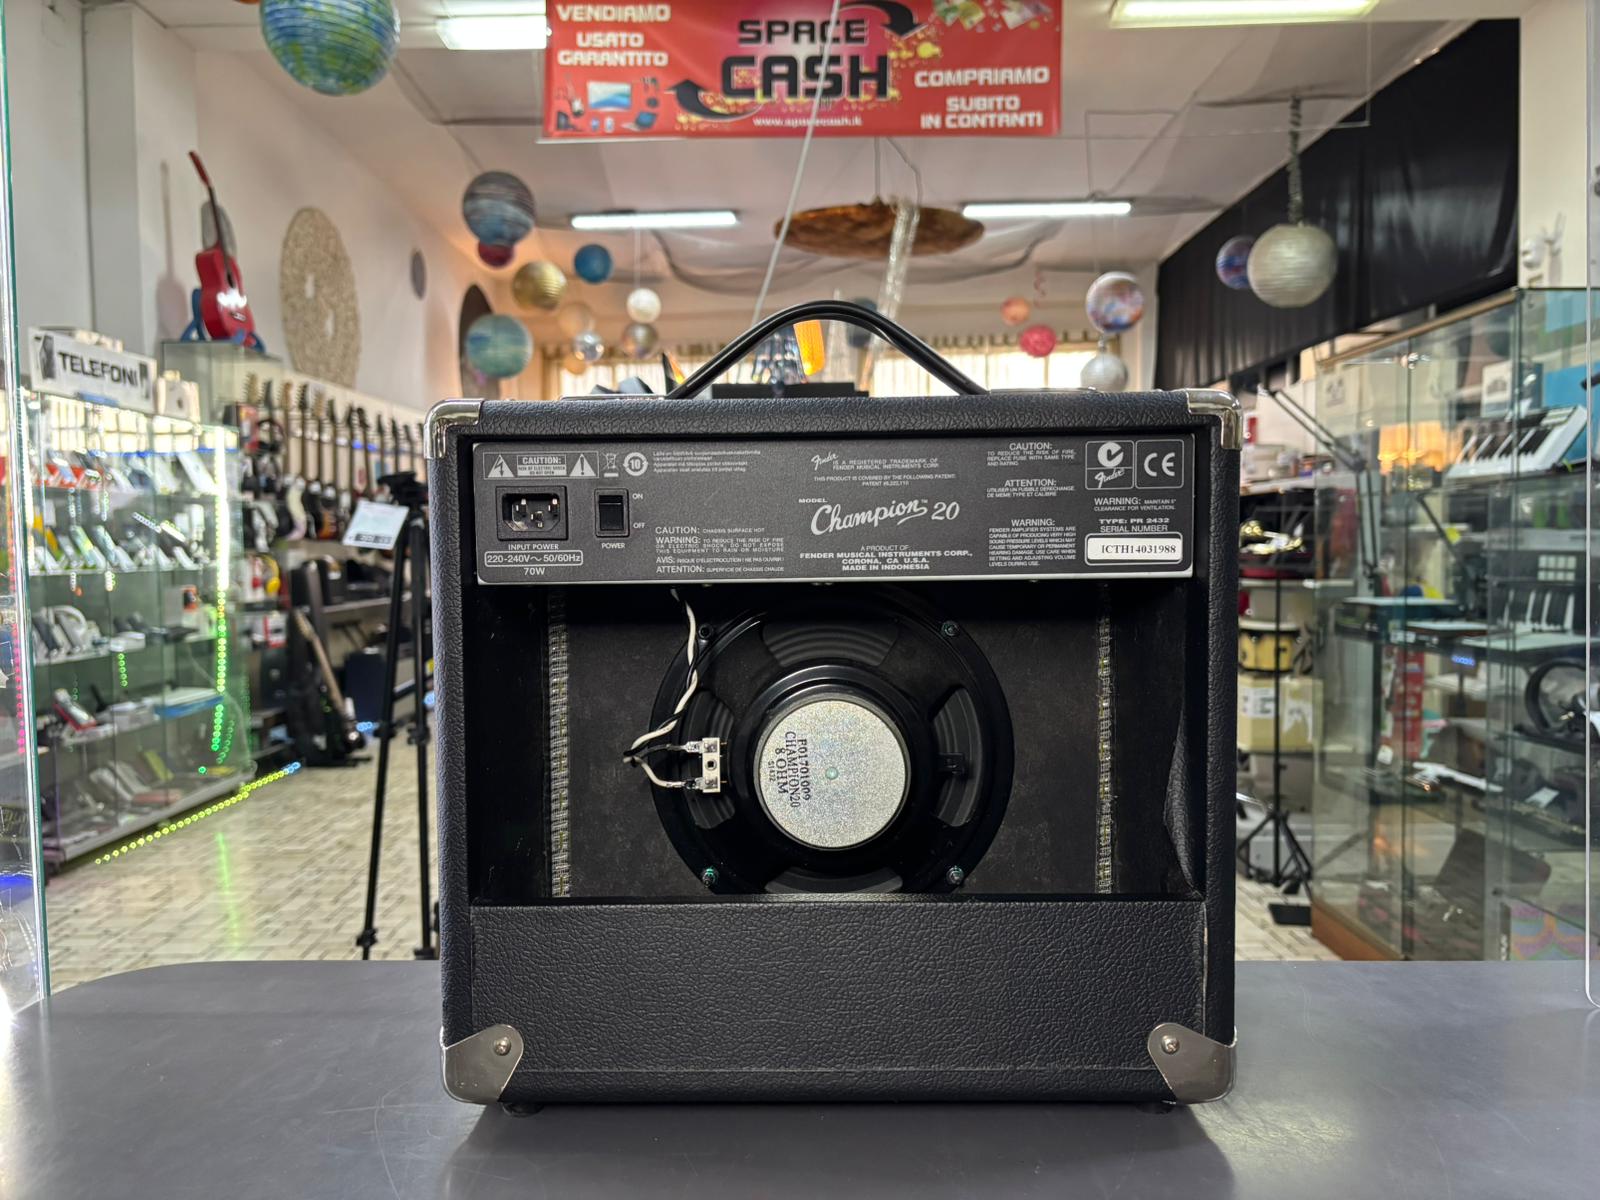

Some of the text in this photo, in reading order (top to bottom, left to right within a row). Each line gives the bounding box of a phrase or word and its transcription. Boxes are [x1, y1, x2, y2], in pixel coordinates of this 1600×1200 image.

[556, 4, 671, 22] VENDIAMO
[739, 20, 865, 44] SPACE
[576, 32, 644, 47] USATO
[558, 51, 668, 66] GARANTITO
[723, 56, 887, 98] CASH
[914, 66, 1050, 88] COMPRIAMO
[946, 95, 1020, 112] SUBITO
[920, 112, 1043, 129] IN CONTANTI
[58, 350, 138, 387] TELEFONI
[1009, 442, 1053, 450] CAUTION:
[522, 456, 562, 465] CAUTION:
[630, 458, 641, 470] 10
[1004, 479, 1056, 487] ATTENTION:
[1094, 497, 1141, 505] WARNING:
[811, 499, 928, 535] Champion
[931, 501, 960, 520] 20
[1011, 518, 1056, 526] WARNING:
[655, 526, 700, 534] CAUTION:
[1100, 525, 1129, 533] SERIAL
[655, 536, 701, 544] WARNING:
[1101, 544, 1176, 554] ICTH14031988
[543, 554, 581, 563] 50/60Hz
[837, 551, 876, 559] MUSICAL
[878, 550, 942, 558] INSTRUMENTS
[523, 567, 546, 576] 70W
[656, 565, 705, 573] ATTENTION:
[775, 747, 789, 794] 8 OHM
